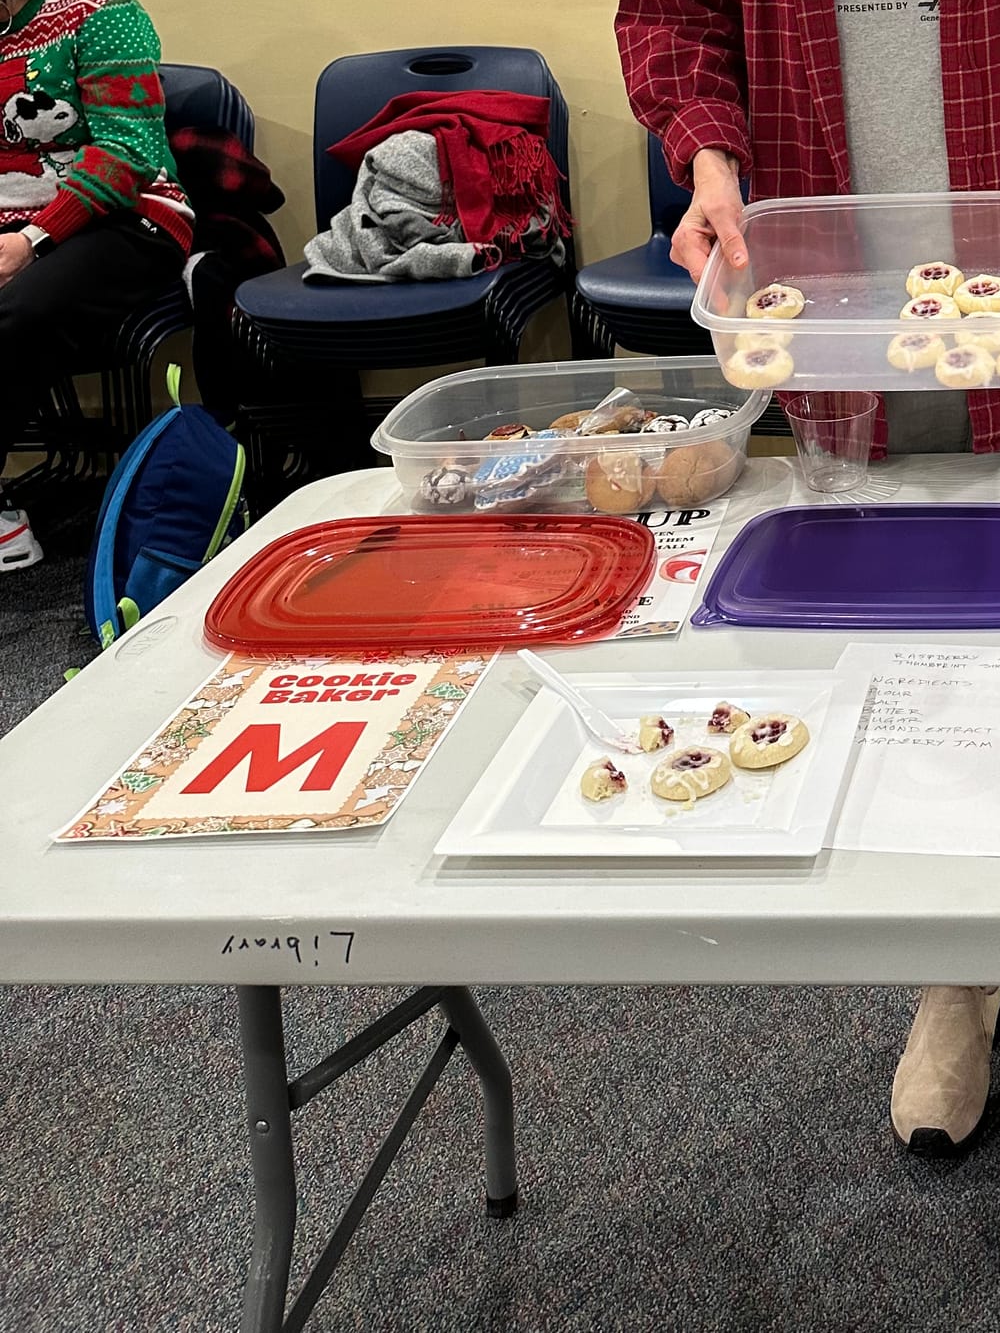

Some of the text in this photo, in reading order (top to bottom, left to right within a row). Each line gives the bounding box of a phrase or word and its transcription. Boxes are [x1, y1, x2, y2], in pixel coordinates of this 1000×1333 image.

[837, 1, 908, 13] PRESENTED BY
[268, 672, 417, 688] Cookie
[871, 675, 973, 686] NGREDIENTS
[259, 688, 401, 704] Baker
[857, 737, 993, 748] ASPBERRY JAM
[179, 721, 368, 795] M
[221, 931, 355, 967] Library
